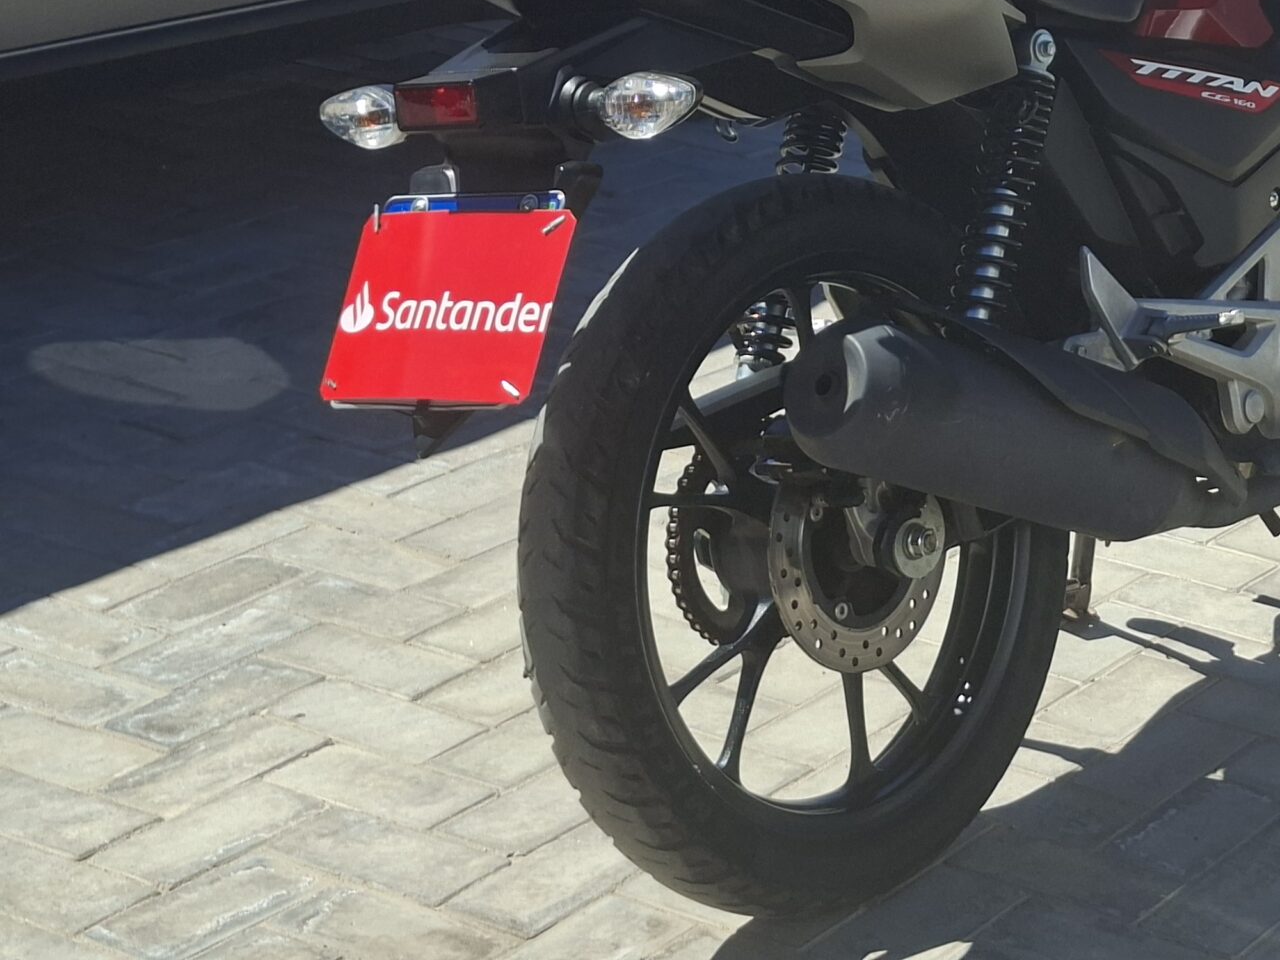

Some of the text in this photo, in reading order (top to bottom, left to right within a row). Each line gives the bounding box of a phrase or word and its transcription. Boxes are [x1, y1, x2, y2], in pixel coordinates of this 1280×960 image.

[1130, 58, 1279, 98] TITAN
[1201, 91, 1256, 109] CG 160
[376, 290, 553, 333] Santander
